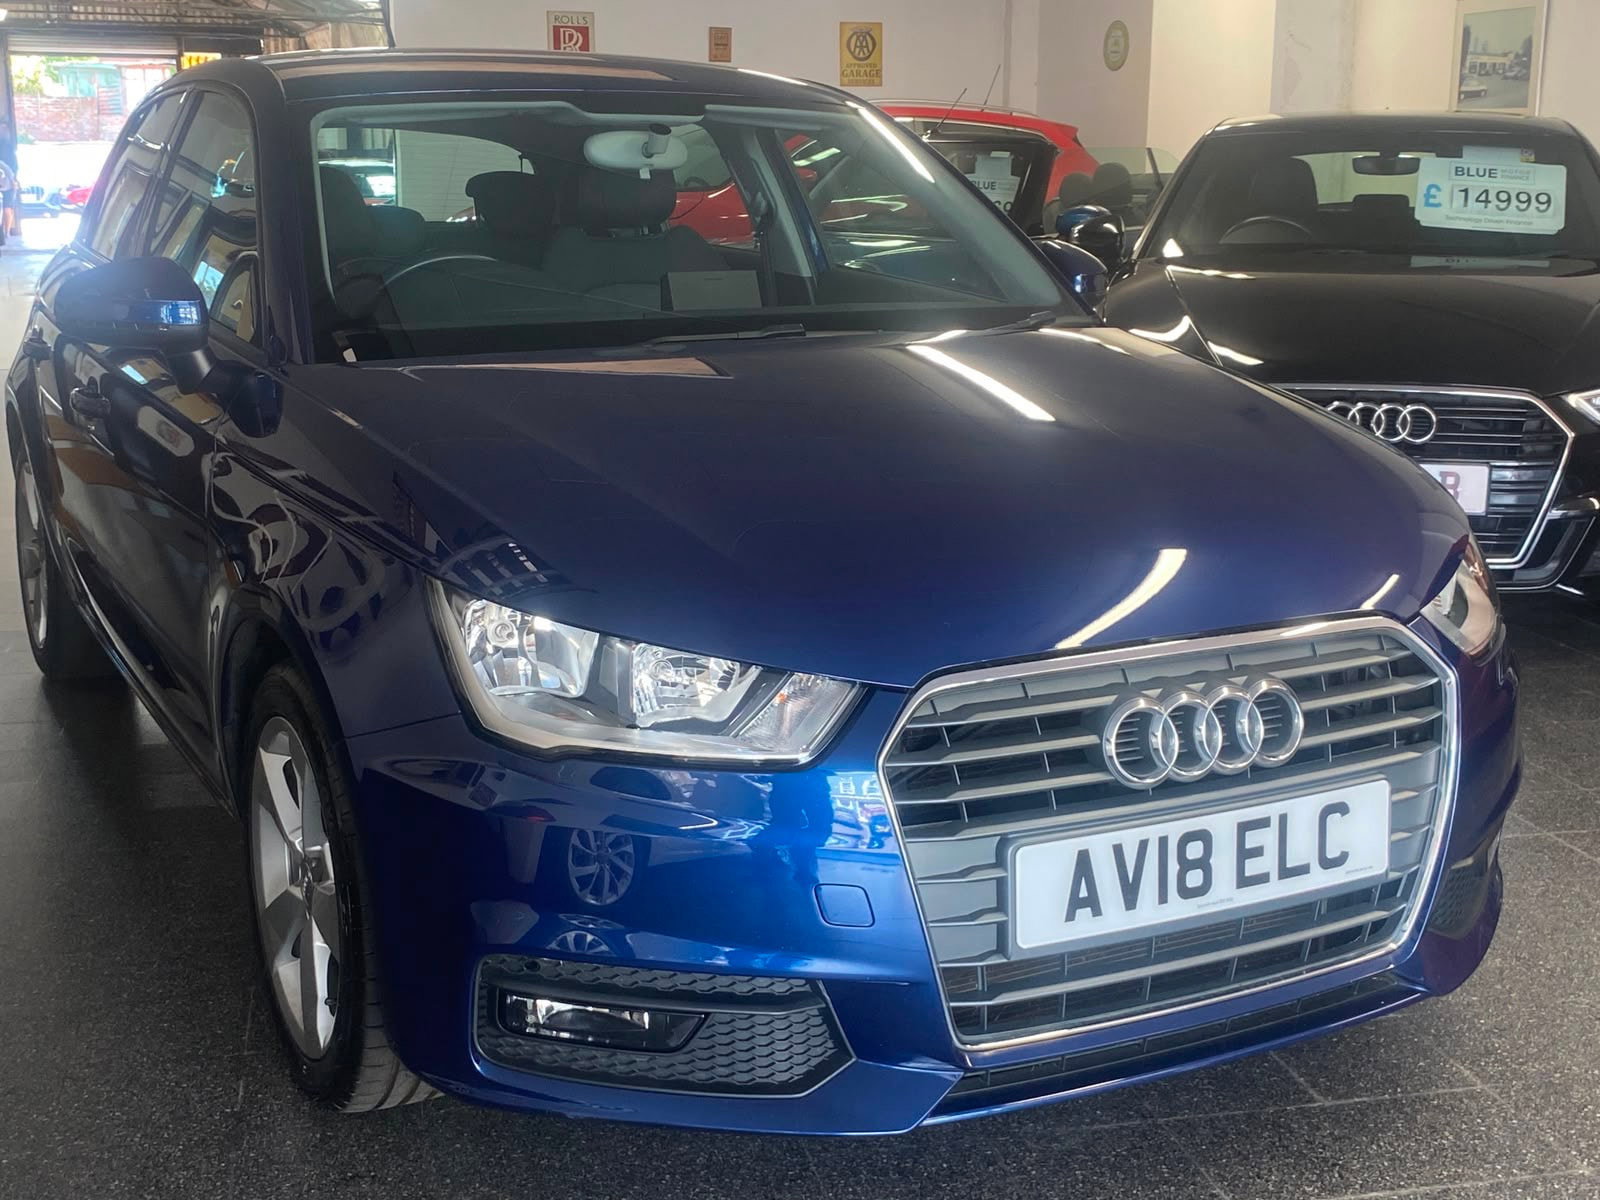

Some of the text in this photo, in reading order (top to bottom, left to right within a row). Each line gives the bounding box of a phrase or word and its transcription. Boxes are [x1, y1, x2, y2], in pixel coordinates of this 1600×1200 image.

[554, 15, 588, 25] ROLLS
[842, 69, 881, 78] GARAGE
[1455, 166, 1498, 178] BLUE
[1458, 187, 1552, 213] 14999
[1064, 801, 1351, 923] AV18 ELC
